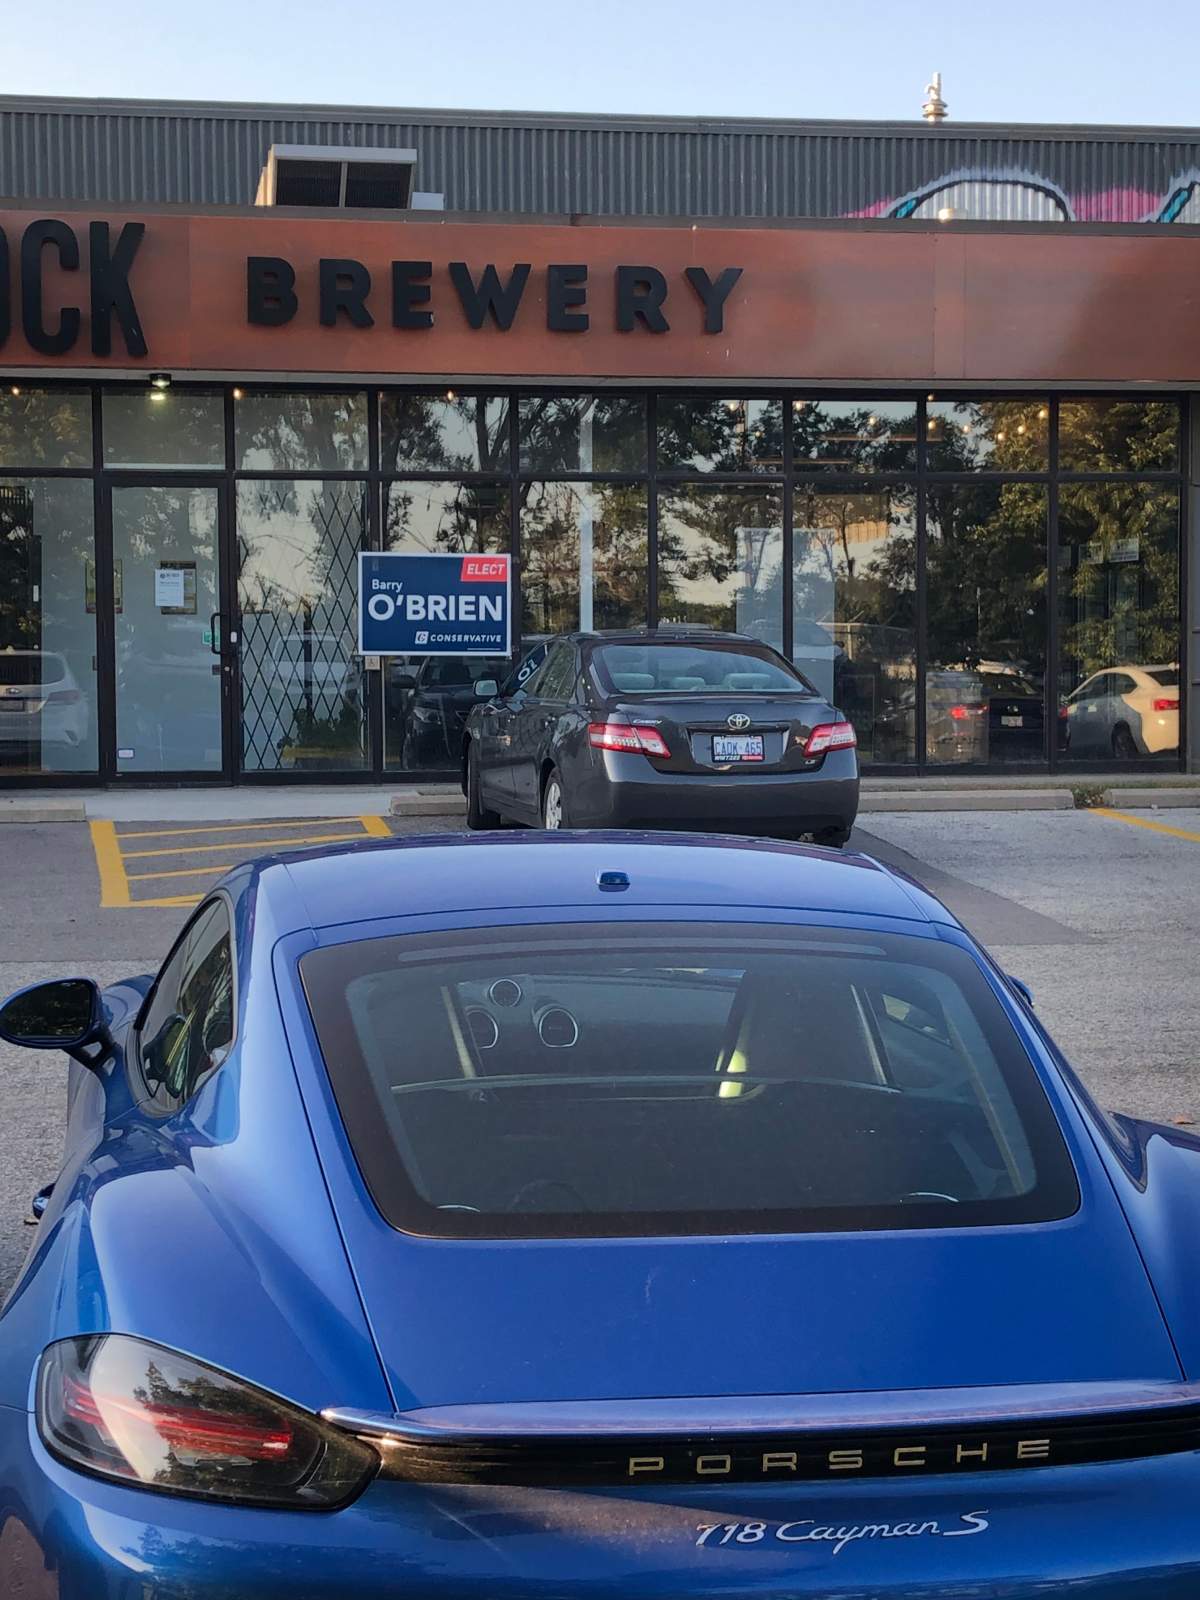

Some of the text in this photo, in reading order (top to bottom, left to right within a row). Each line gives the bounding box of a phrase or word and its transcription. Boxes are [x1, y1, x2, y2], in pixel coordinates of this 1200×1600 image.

[0, 218, 744, 358] CK BREWERY
[467, 563, 505, 576] ELECT
[371, 578, 403, 593] Barry
[368, 593, 502, 621] O'BRIEN
[430, 634, 502, 643] CONSERVATIVE
[629, 1439, 1051, 1476] PORSCHE
[695, 1510, 990, 1555] 718 Cayman S
